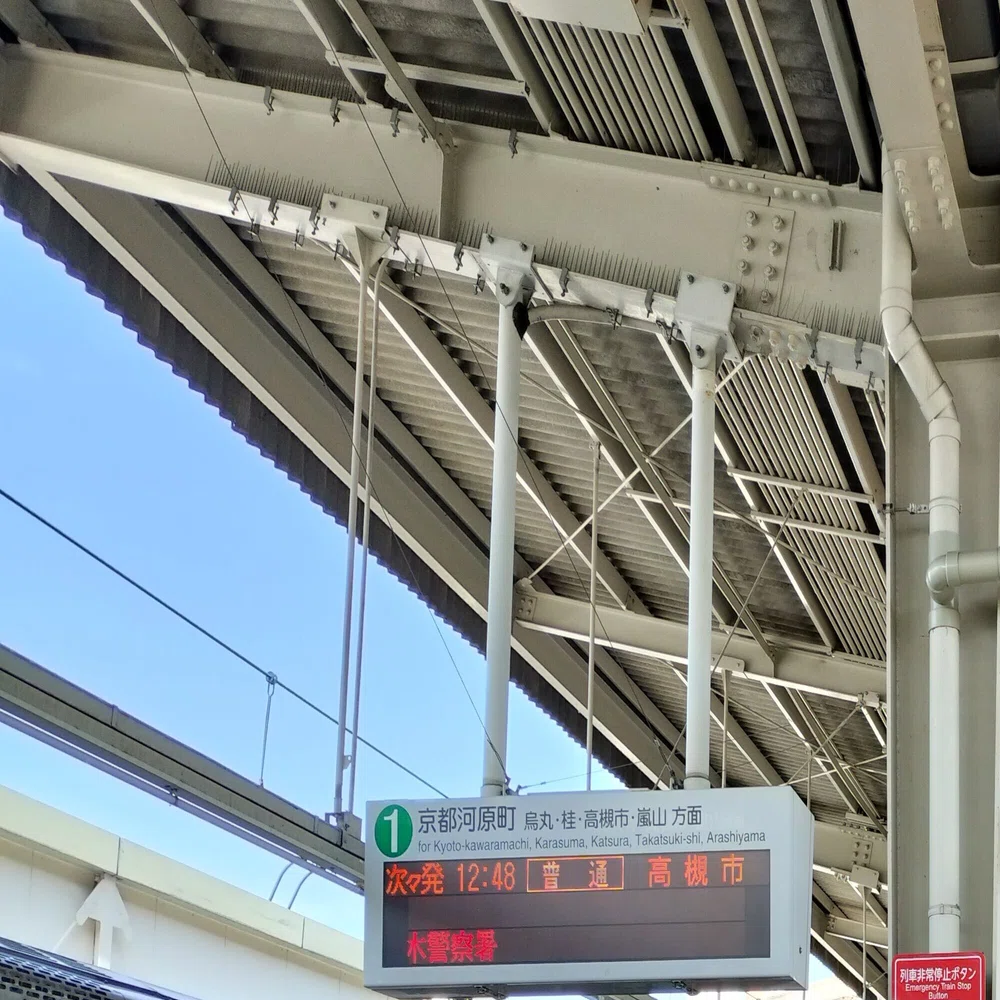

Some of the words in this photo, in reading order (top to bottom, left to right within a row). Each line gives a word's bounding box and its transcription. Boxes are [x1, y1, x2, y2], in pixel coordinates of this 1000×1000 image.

[384, 809, 398, 853] 1
[418, 805, 516, 834] 京都河原町
[671, 805, 702, 827] 方面
[418, 841, 432, 852] for
[434, 838, 532, 854] Kyoto-kawaramachi,
[535, 837, 588, 850] Karasuma,
[591, 835, 632, 848] Katsura,
[635, 832, 703, 846] Takatsuki-shi,
[707, 831, 766, 846] Arashiyama
[385, 862, 445, 895] 次々発
[457, 861, 516, 892] 12:48
[542, 860, 609, 890] 普通
[647, 853, 745, 888] 高槻市
[900, 966, 976, 983] 列車非常停止ボタン
[905, 983, 940, 993] Emergency
[941, 982, 956, 991] Train
[957, 981, 972, 991] Stop
[928, 992, 948, 1000] Button
